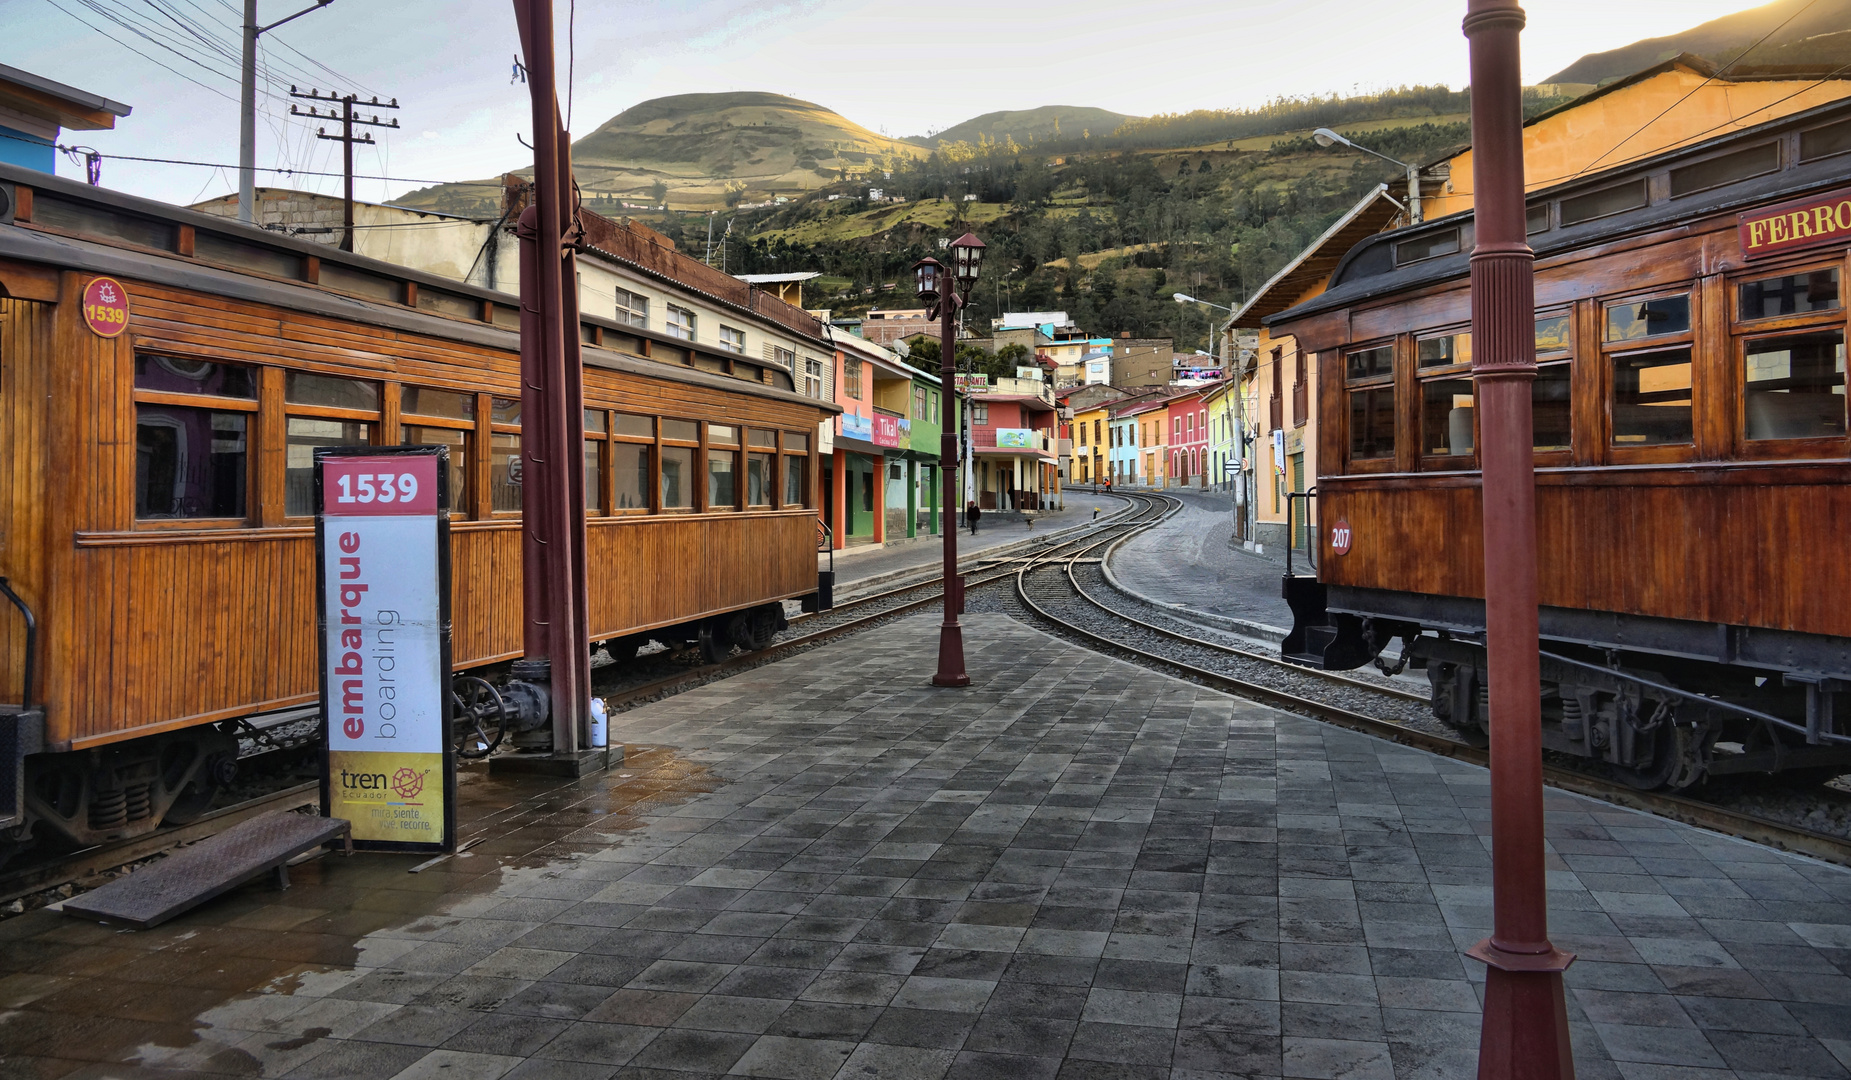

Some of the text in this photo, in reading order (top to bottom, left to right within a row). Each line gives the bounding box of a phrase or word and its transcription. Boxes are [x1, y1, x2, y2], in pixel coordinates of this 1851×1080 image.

[1746, 200, 1851, 249] FERRO
[88, 305, 124, 324] 1539
[880, 418, 897, 437] Tikal
[337, 473, 419, 504] 1539
[1332, 528, 1350, 548] 207
[335, 531, 368, 740] embarque
[372, 608, 400, 740] boarding
[341, 768, 387, 789] tren
[342, 791, 387, 799] Ecuador
